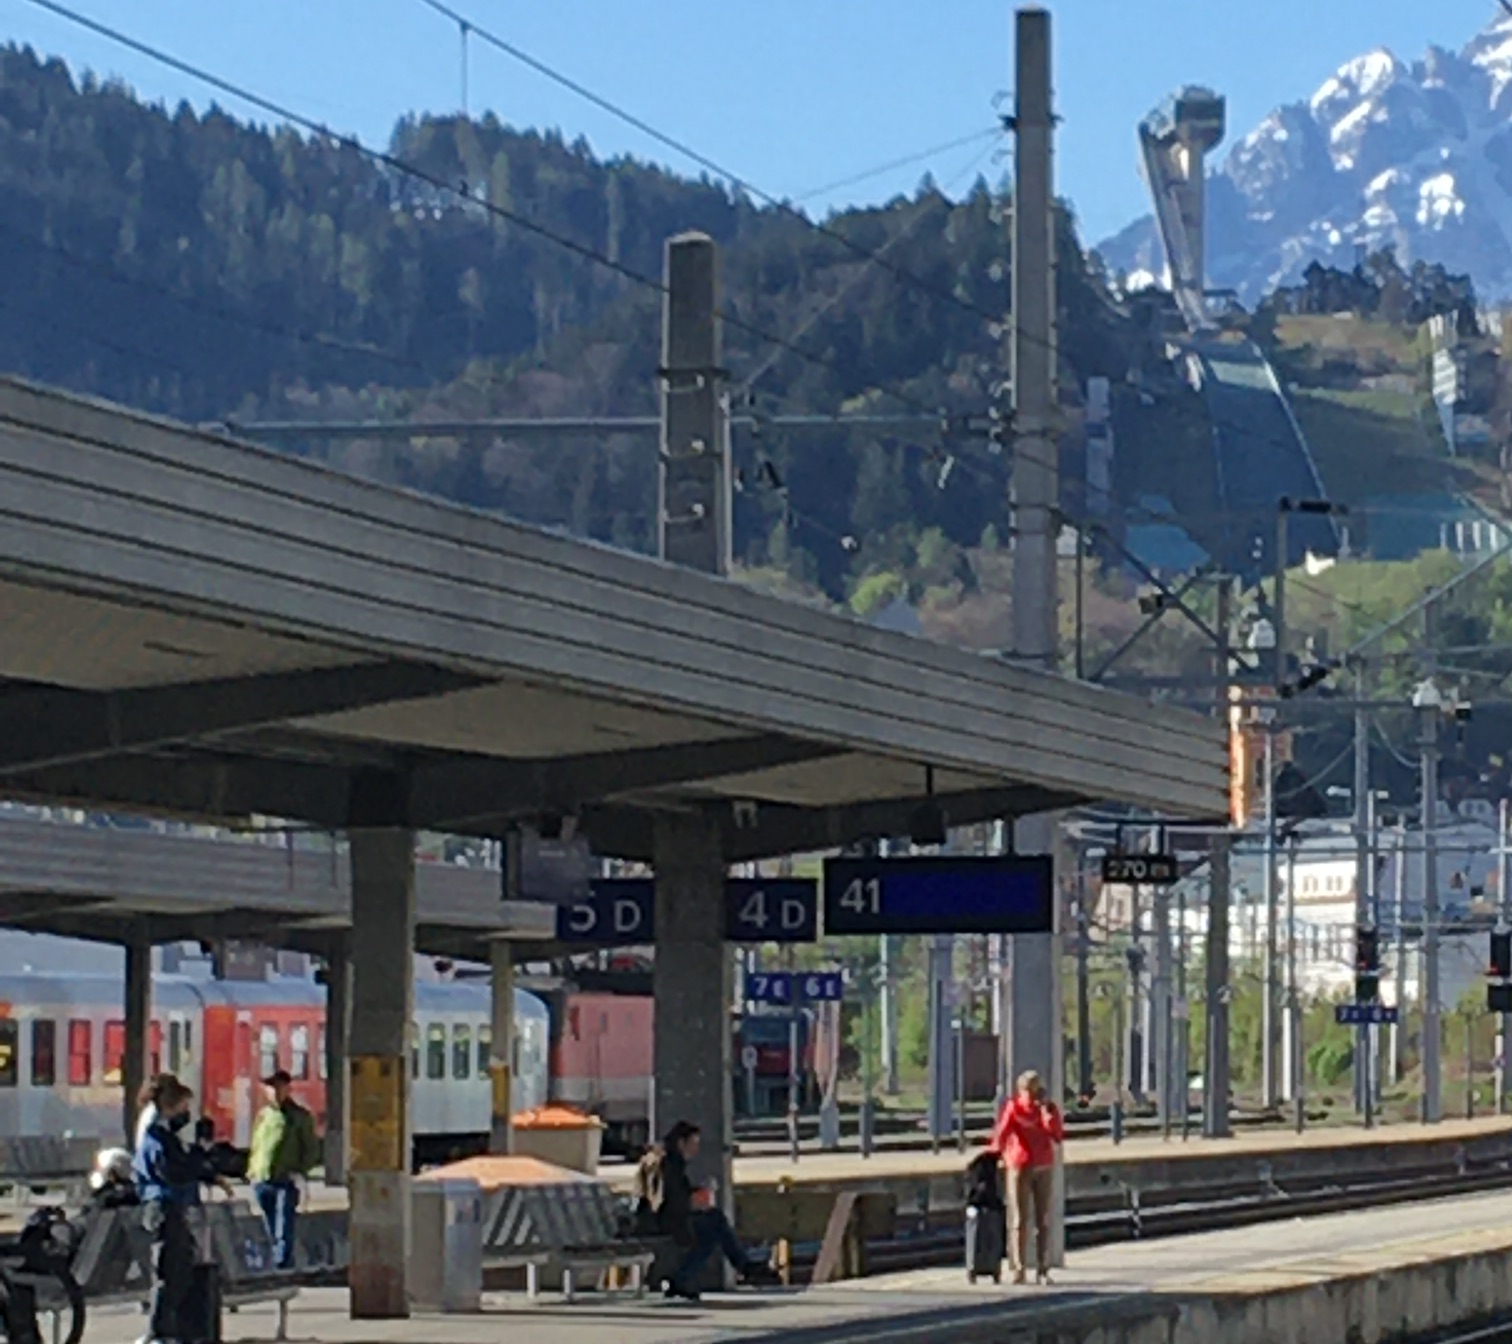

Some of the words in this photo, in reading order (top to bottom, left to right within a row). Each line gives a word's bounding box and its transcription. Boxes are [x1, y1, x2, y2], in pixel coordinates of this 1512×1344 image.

[569, 890, 598, 932] 5
[614, 900, 641, 932] D
[739, 891, 768, 929] 4
[781, 900, 806, 930] D
[839, 878, 880, 914] 41
[754, 977, 768, 997] 7
[806, 977, 820, 996] 6
